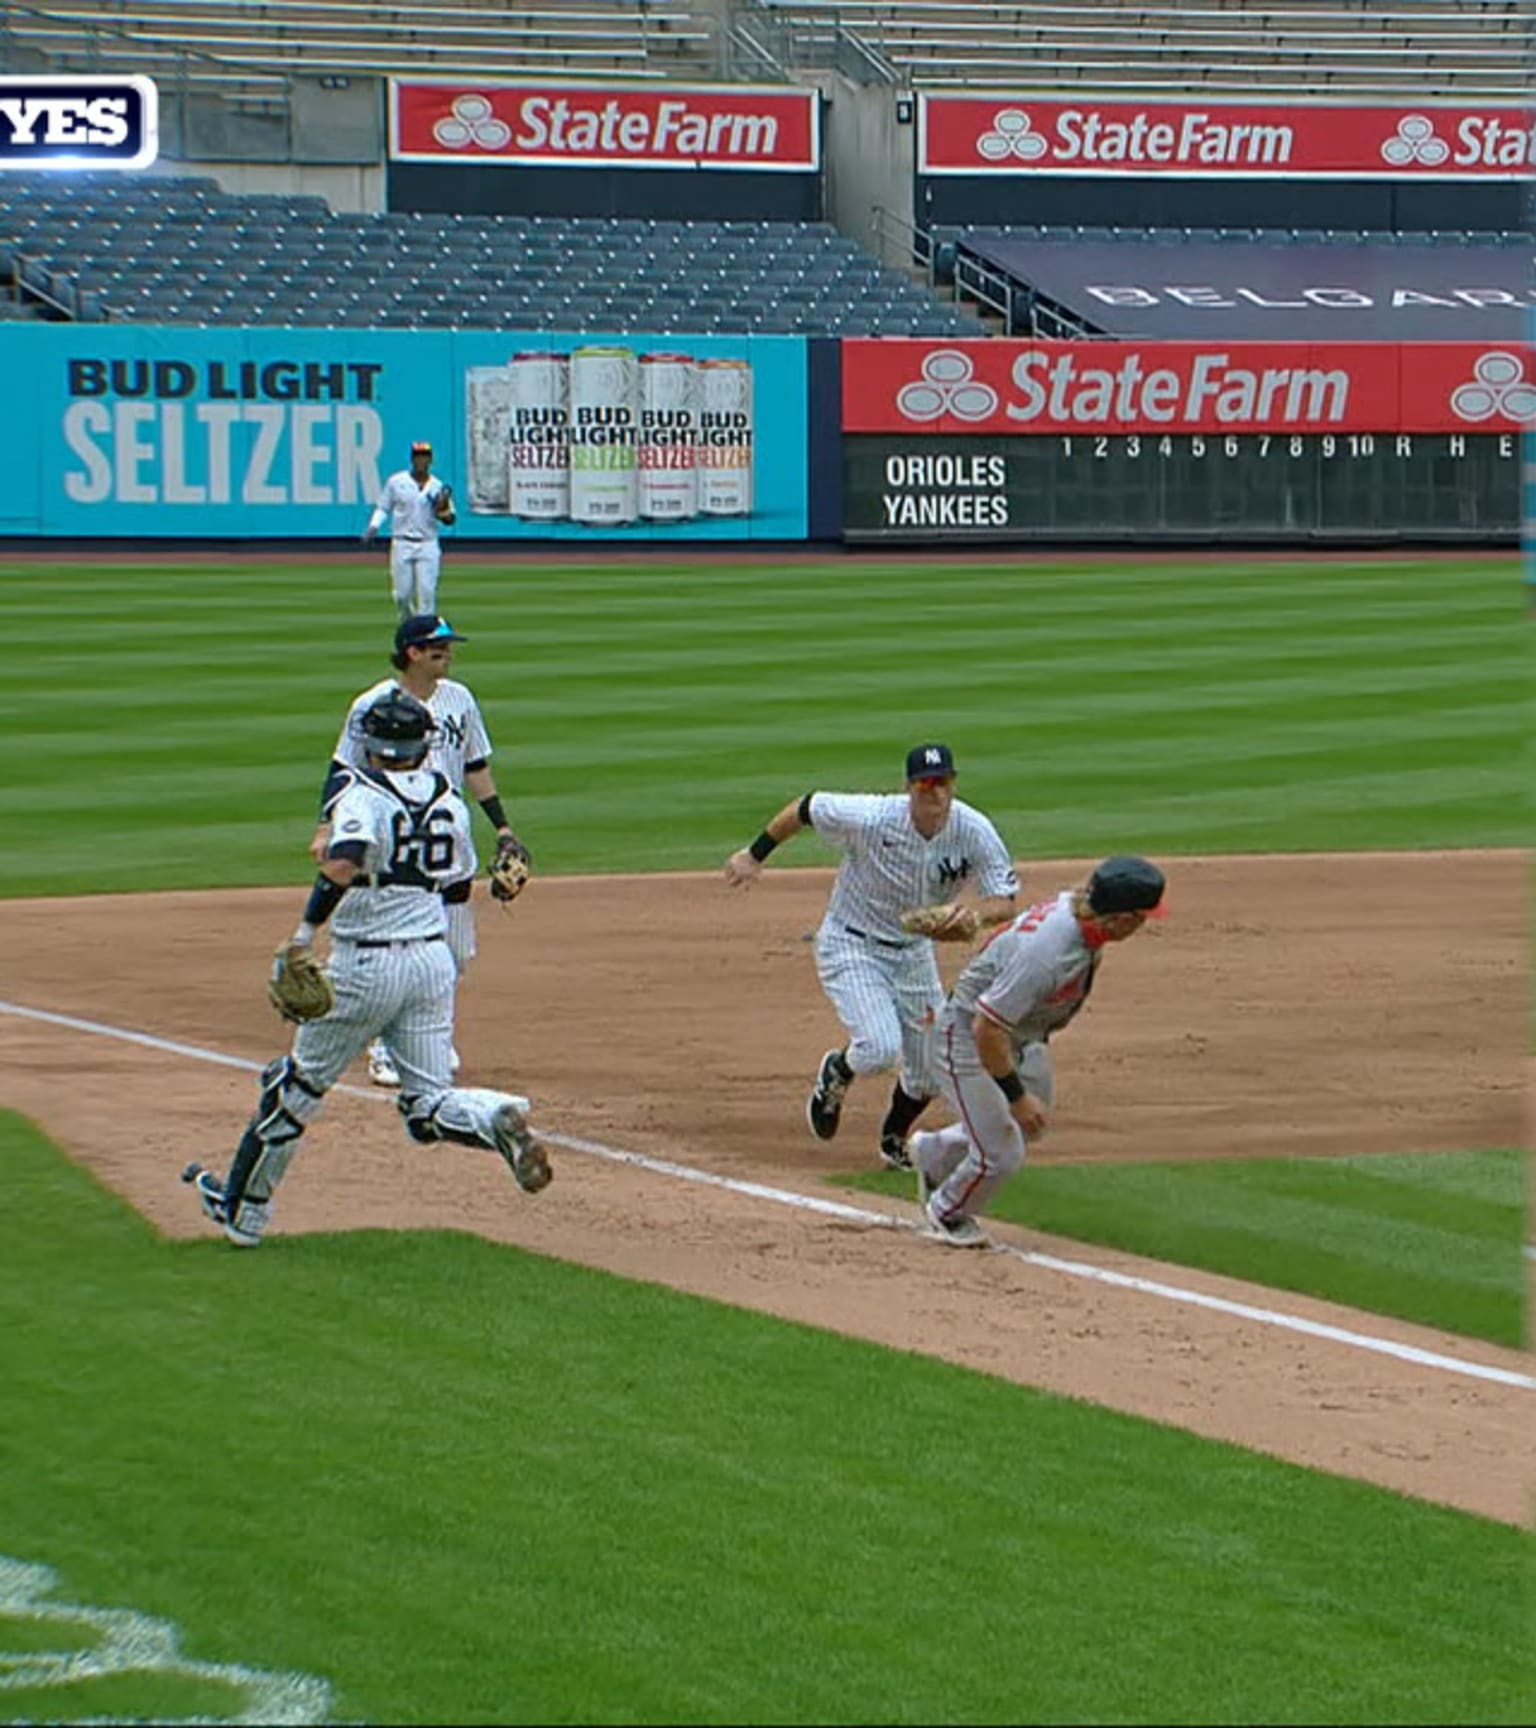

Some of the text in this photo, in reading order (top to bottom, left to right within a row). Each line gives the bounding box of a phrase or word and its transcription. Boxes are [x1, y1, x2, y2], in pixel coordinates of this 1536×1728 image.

[67, 358, 382, 400] BUD LIGHT
[516, 408, 566, 426] BUD
[578, 407, 630, 425] BUD
[641, 410, 691, 428] BUD
[701, 412, 747, 428] BUD
[62, 400, 384, 505] SELTZER
[1061, 436, 1512, 457] 1 2 3 4 5 6 7 8 9 10 R H E
[886, 455, 1006, 487] ORIOLES
[884, 495, 1008, 526] YANKEES
